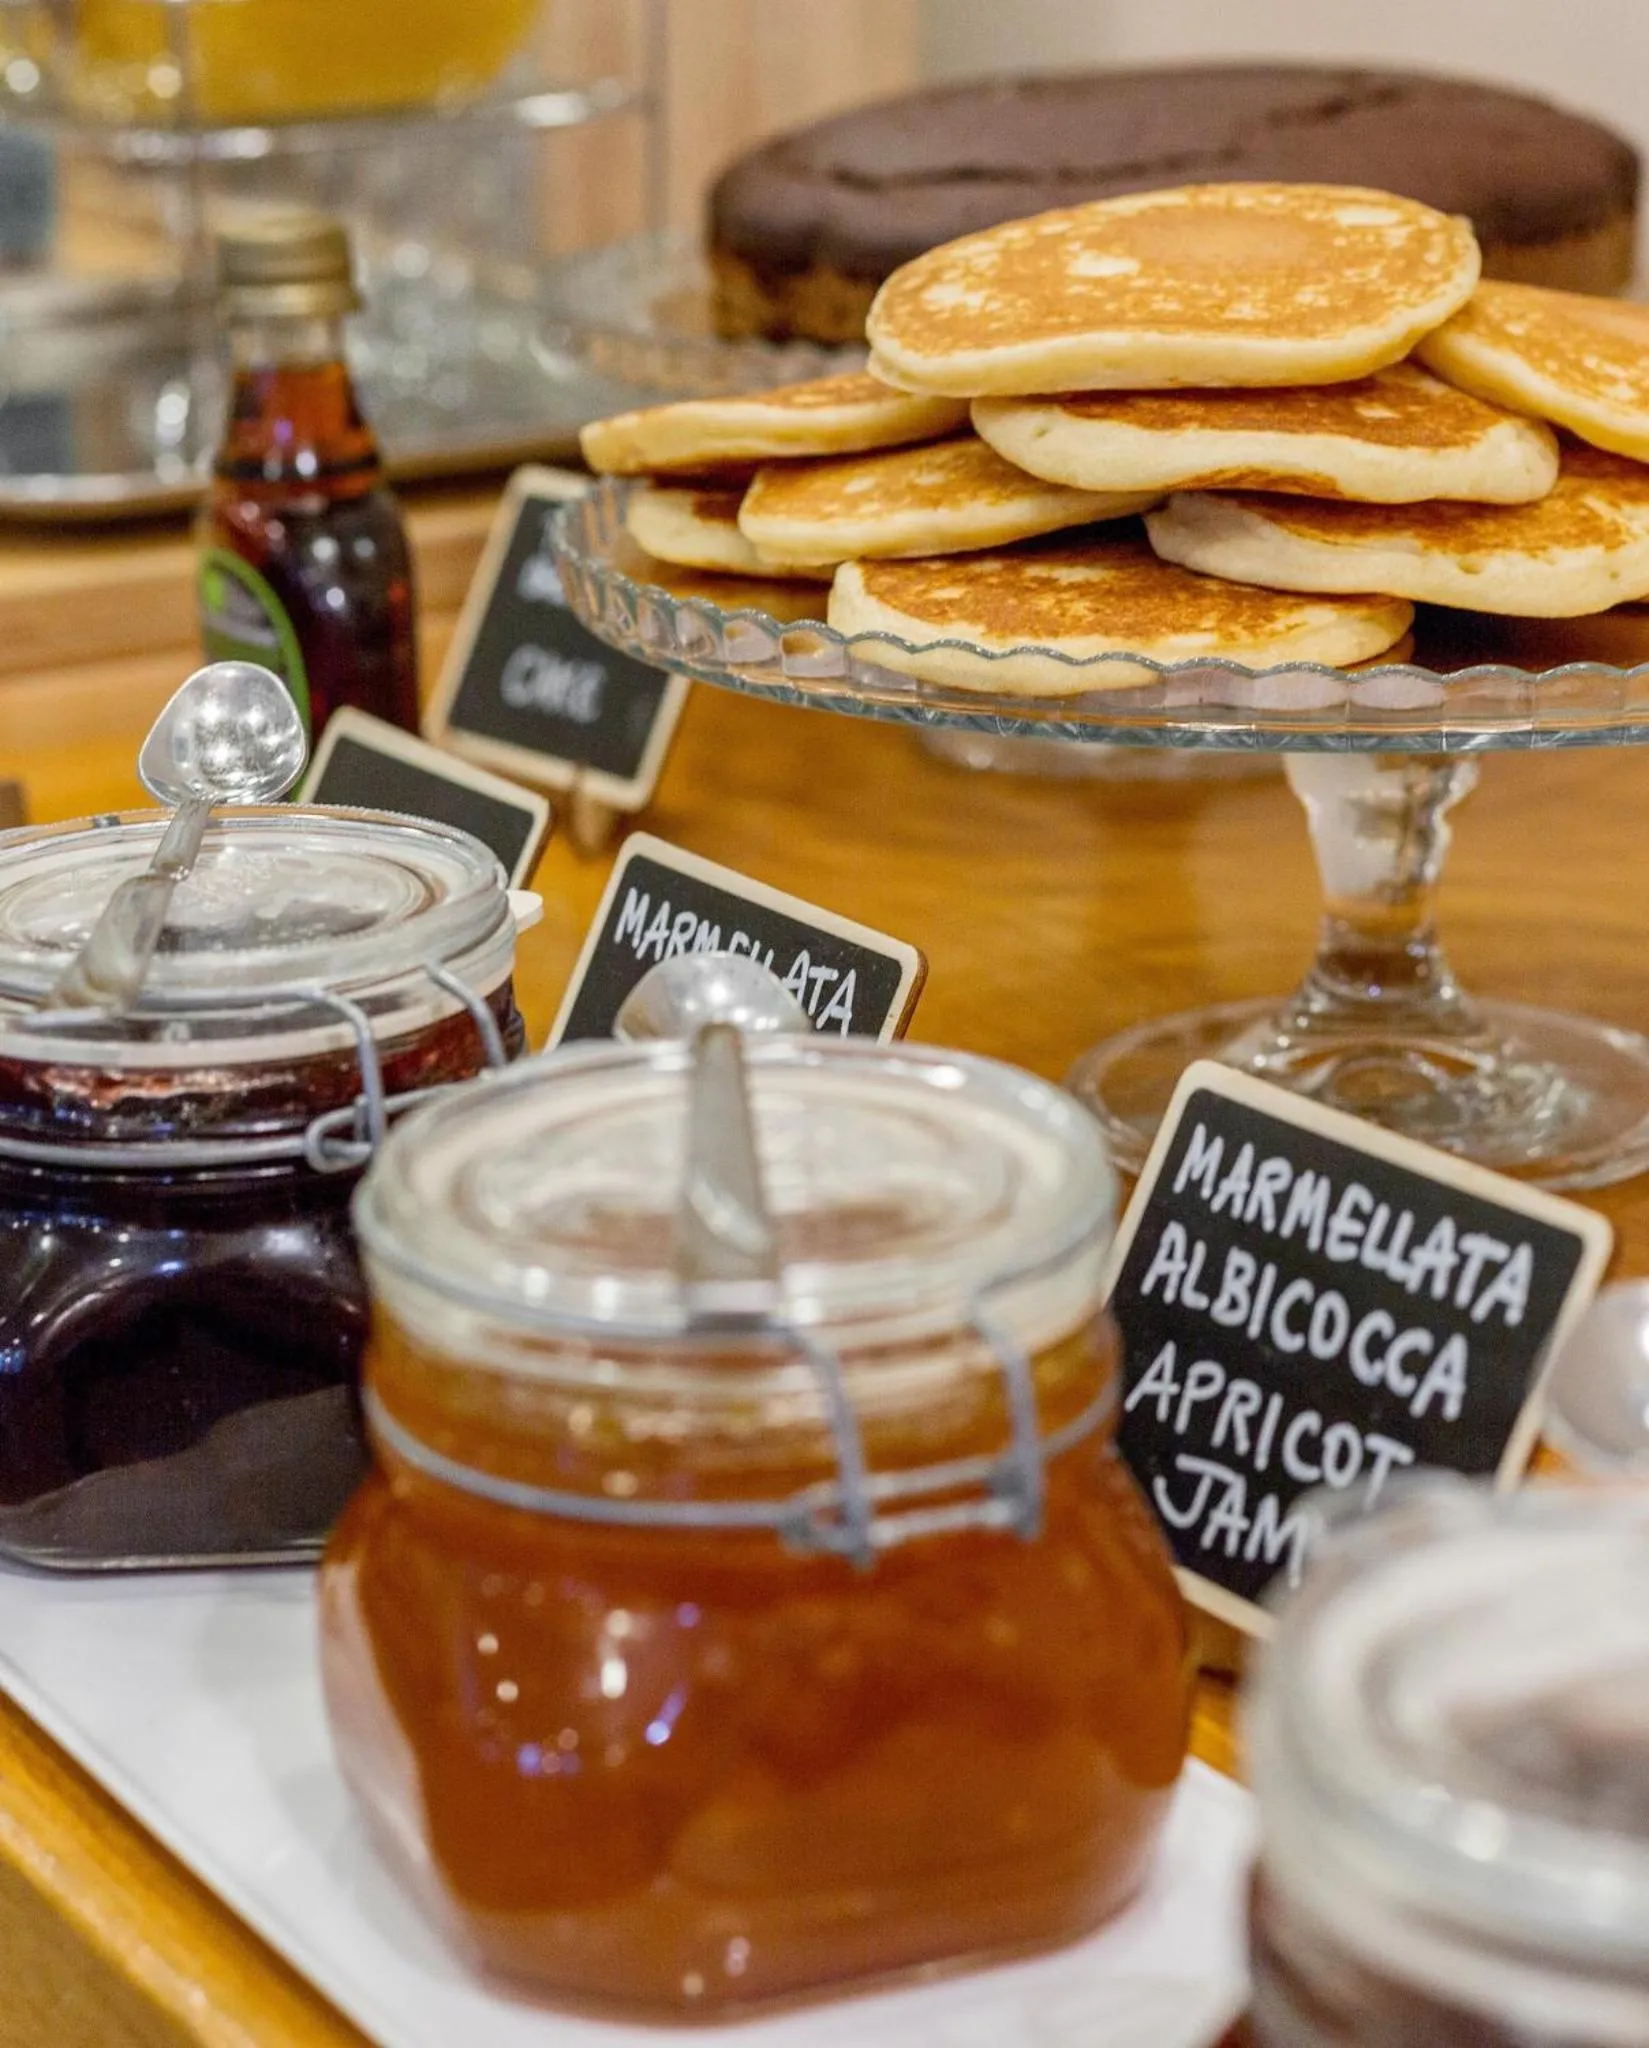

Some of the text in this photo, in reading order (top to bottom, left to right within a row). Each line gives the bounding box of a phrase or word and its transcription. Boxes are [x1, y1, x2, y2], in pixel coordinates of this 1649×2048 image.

[1173, 1122, 1535, 1327] MARMELLATA
[1140, 1221, 1469, 1420] ALBICOCCA
[1124, 1340, 1415, 1508] APRICOT
[1153, 1453, 1309, 1589] JAM
